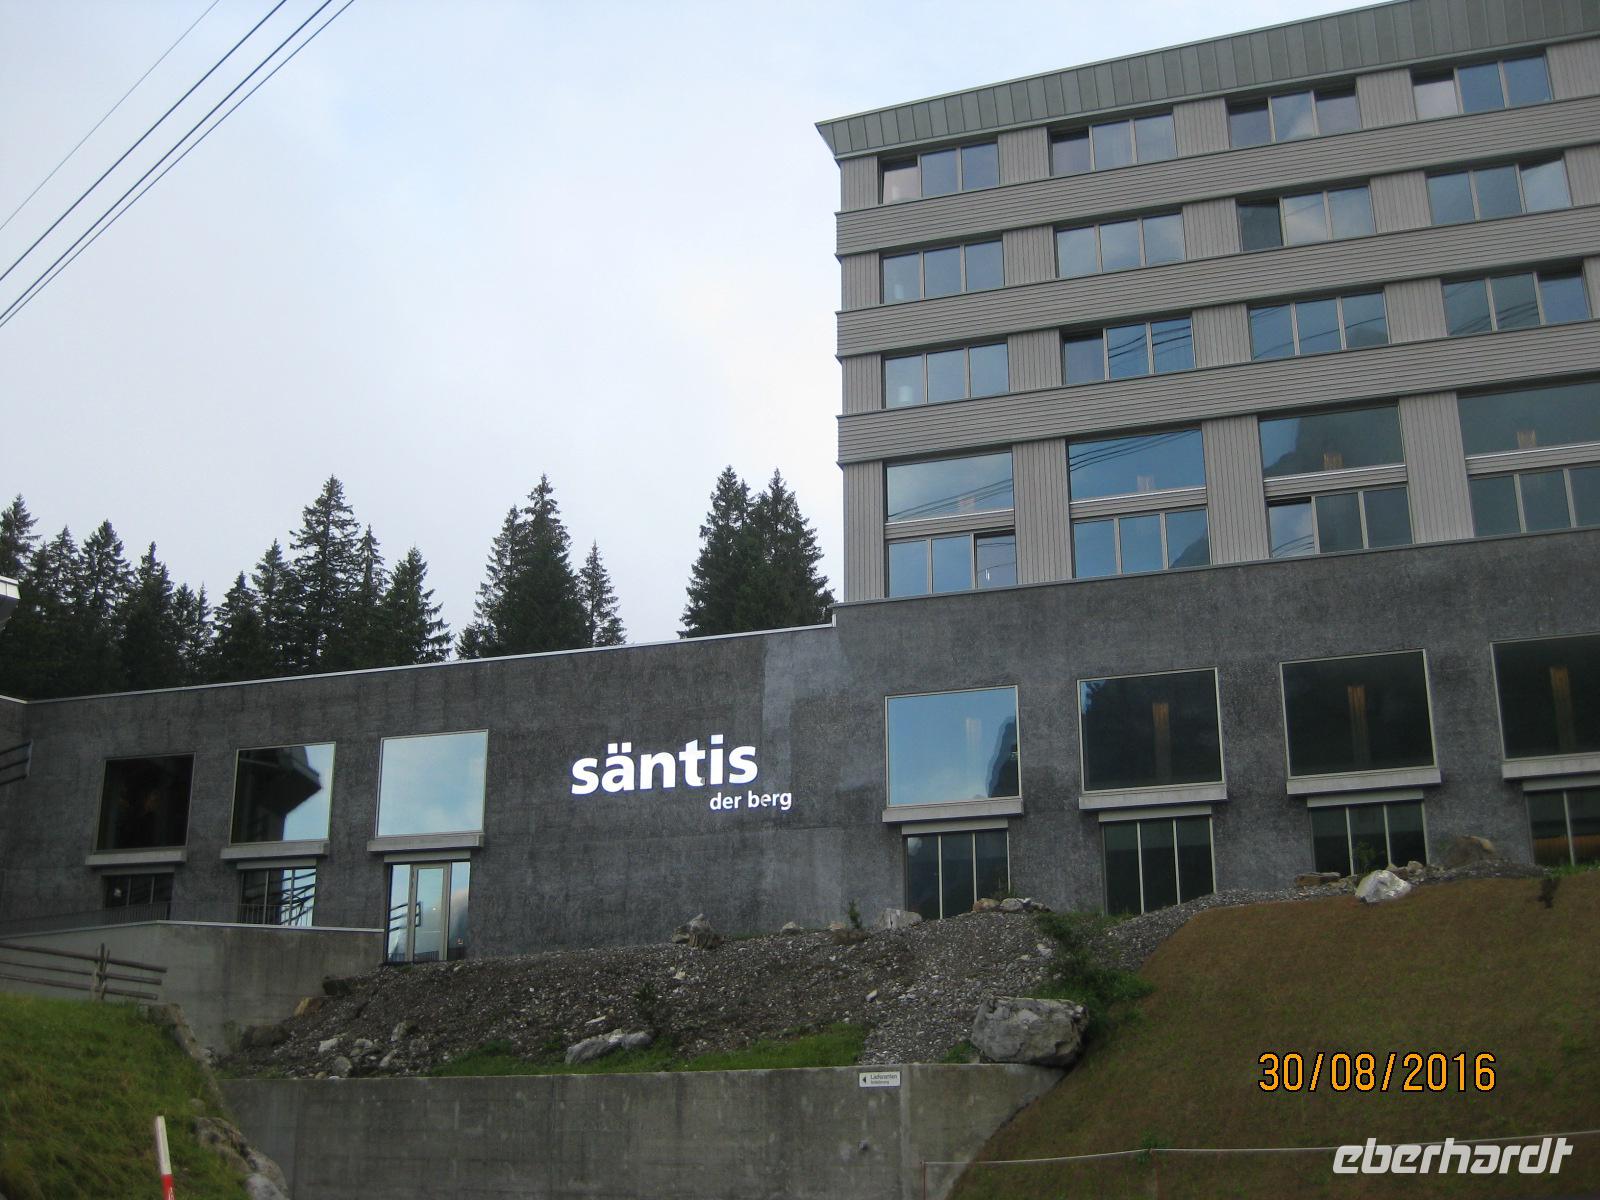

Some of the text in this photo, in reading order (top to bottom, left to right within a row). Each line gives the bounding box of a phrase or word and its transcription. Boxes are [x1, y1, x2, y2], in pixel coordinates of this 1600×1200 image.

[571, 734, 758, 795] säntis
[709, 790, 792, 811] der berg
